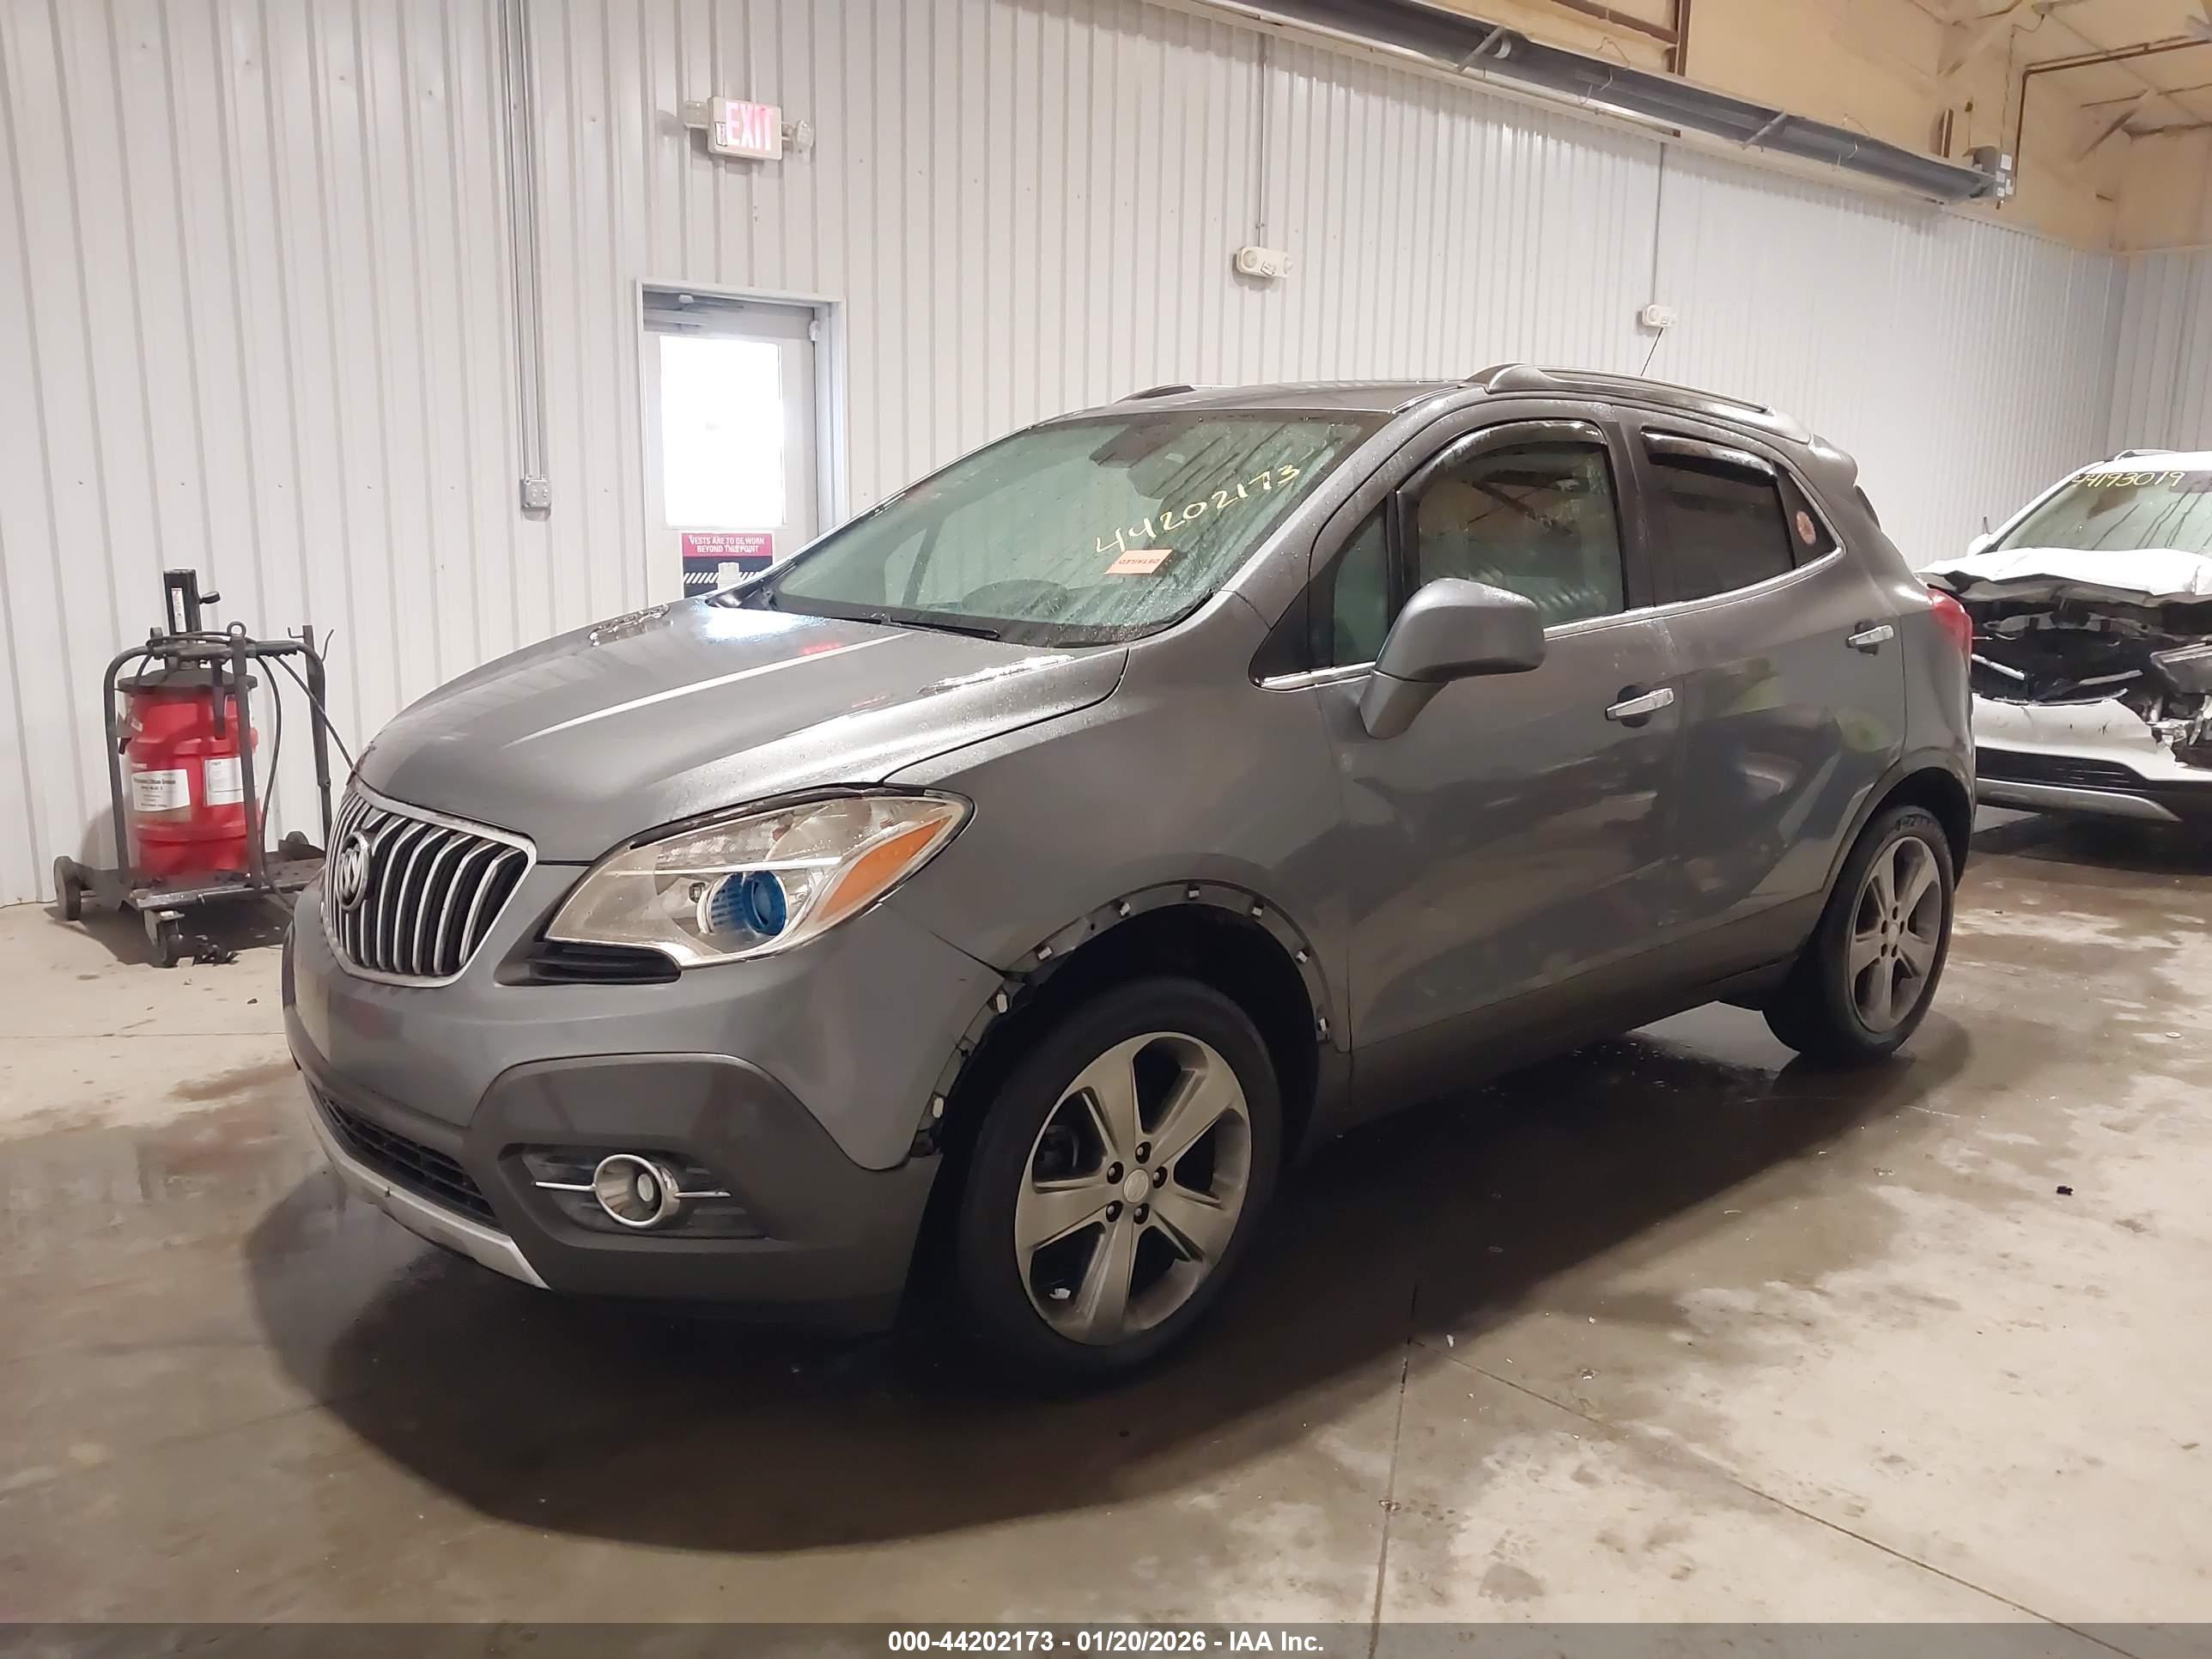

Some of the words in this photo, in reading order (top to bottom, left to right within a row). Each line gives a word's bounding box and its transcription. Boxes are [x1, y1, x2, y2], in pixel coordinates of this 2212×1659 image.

[726, 101, 772, 151] EXIT
[2072, 471, 2185, 488] 44193019
[1096, 464, 1300, 552] 44202173
[689, 534, 711, 545] VESTS
[712, 536, 725, 545] ARE
[726, 537, 735, 545] TO
[744, 537, 764, 545] WORN
[696, 544, 723, 553] BEYOND
[724, 544, 739, 553] THIS
[739, 544, 759, 554] POINT
